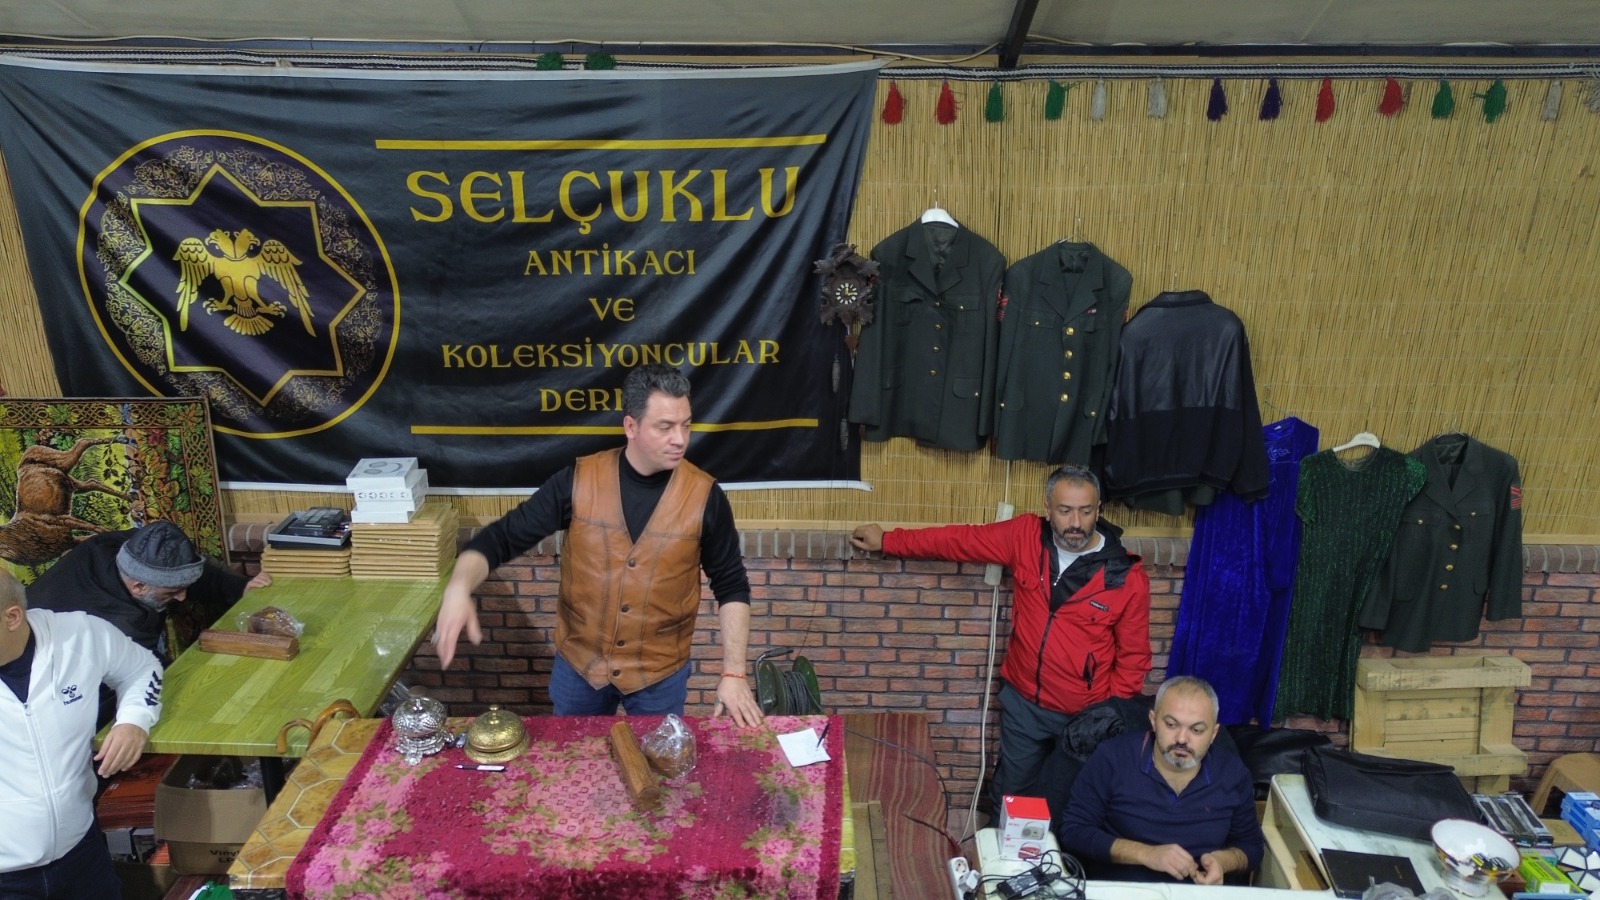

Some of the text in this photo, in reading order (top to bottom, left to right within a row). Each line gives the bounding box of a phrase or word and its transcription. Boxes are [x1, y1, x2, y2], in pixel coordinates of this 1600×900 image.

[406, 166, 800, 236] SELÇUKLU
[524, 244, 696, 276] ANTİKACI
[590, 297, 635, 322] VE
[441, 337, 780, 368] KOLEKSİYONCULAR
